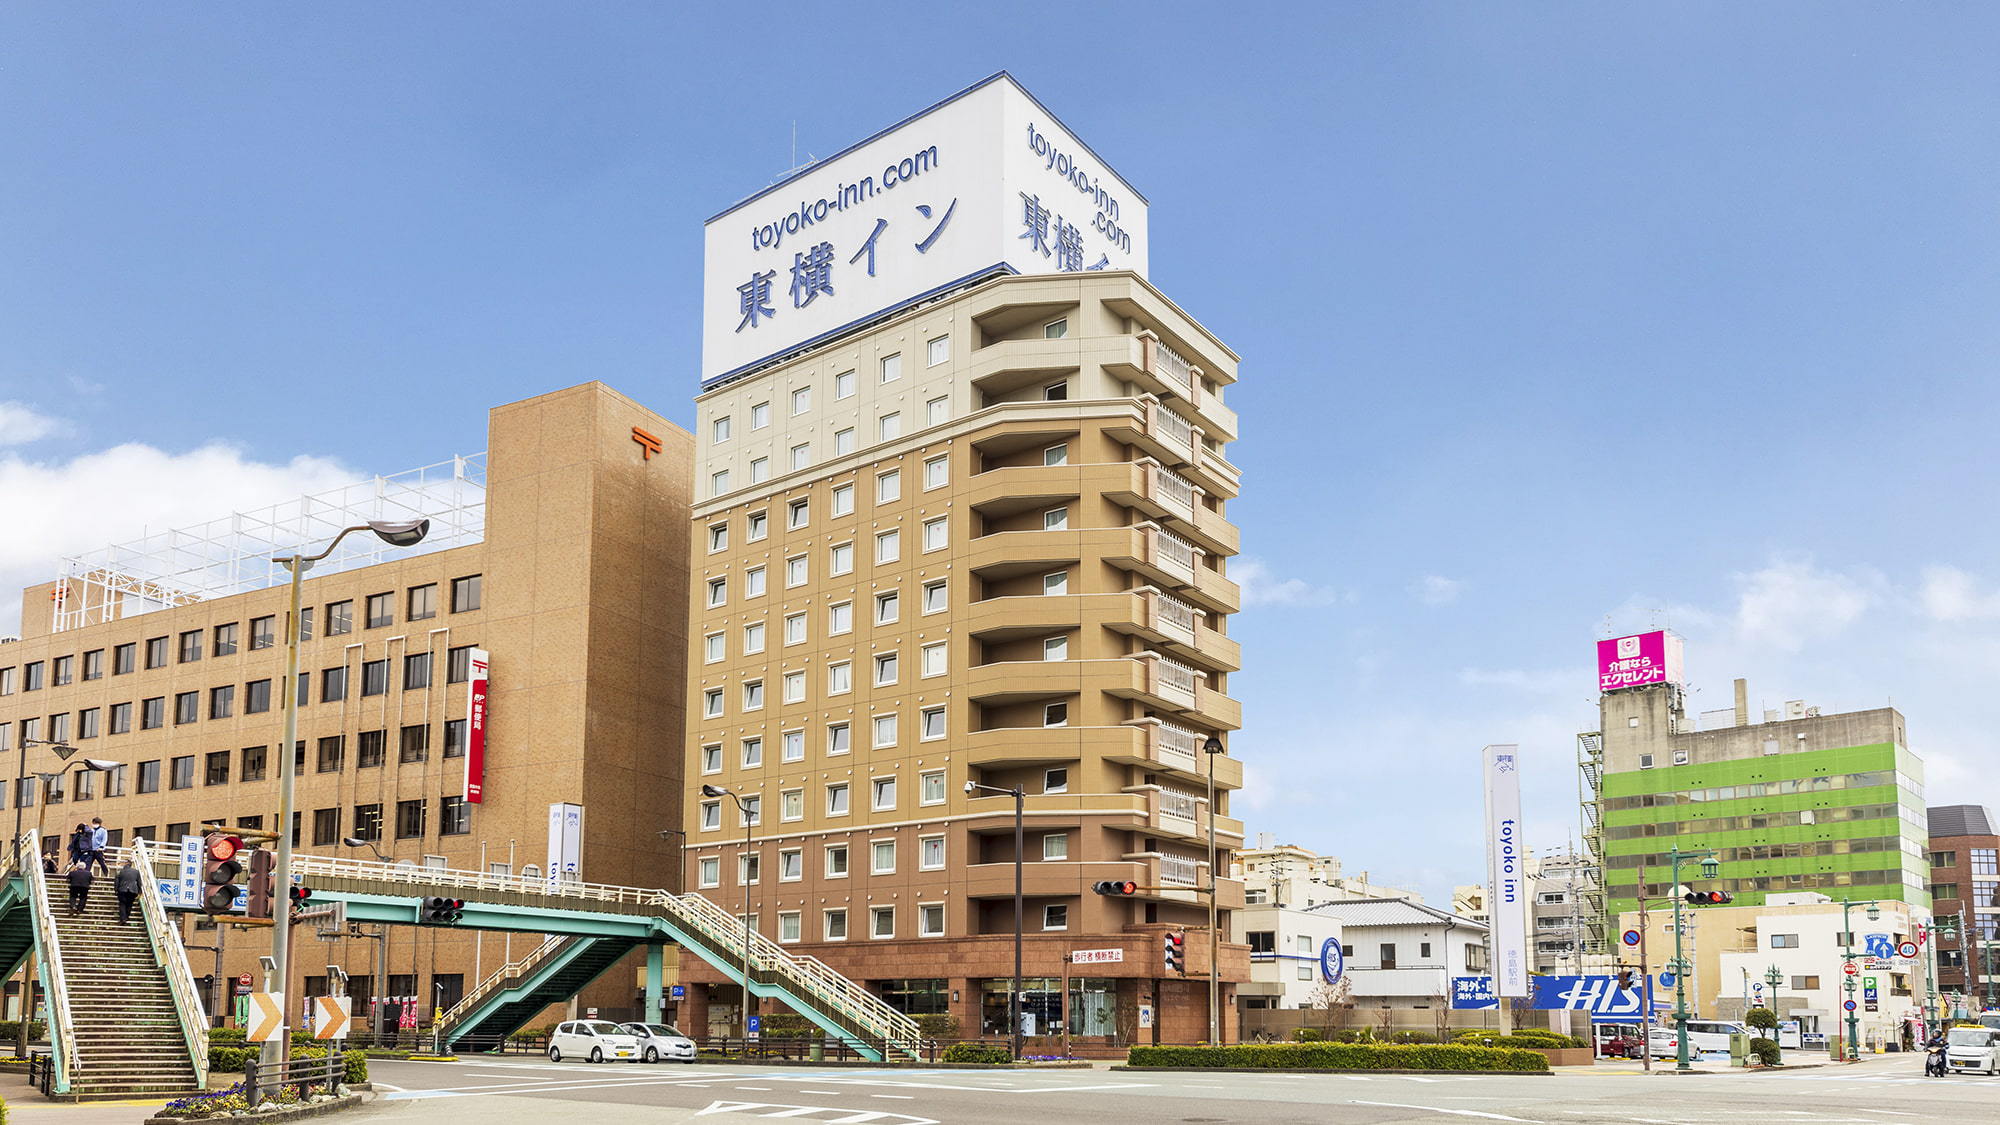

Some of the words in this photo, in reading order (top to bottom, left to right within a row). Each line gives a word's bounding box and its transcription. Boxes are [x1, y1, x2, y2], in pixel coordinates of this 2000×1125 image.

[1027, 122, 1120, 222] toyoko-inn
[751, 145, 939, 252] toyoko-inn.com
[735, 197, 958, 334] 東横イン
[1600, 667, 1664, 687] エクセレント
[1500, 819, 1517, 873] toyoko
[1504, 879, 1518, 903] inn
[1902, 945, 1915, 955] 40
[1865, 978, 1875, 989] P
[750, 1019, 758, 1029] P
